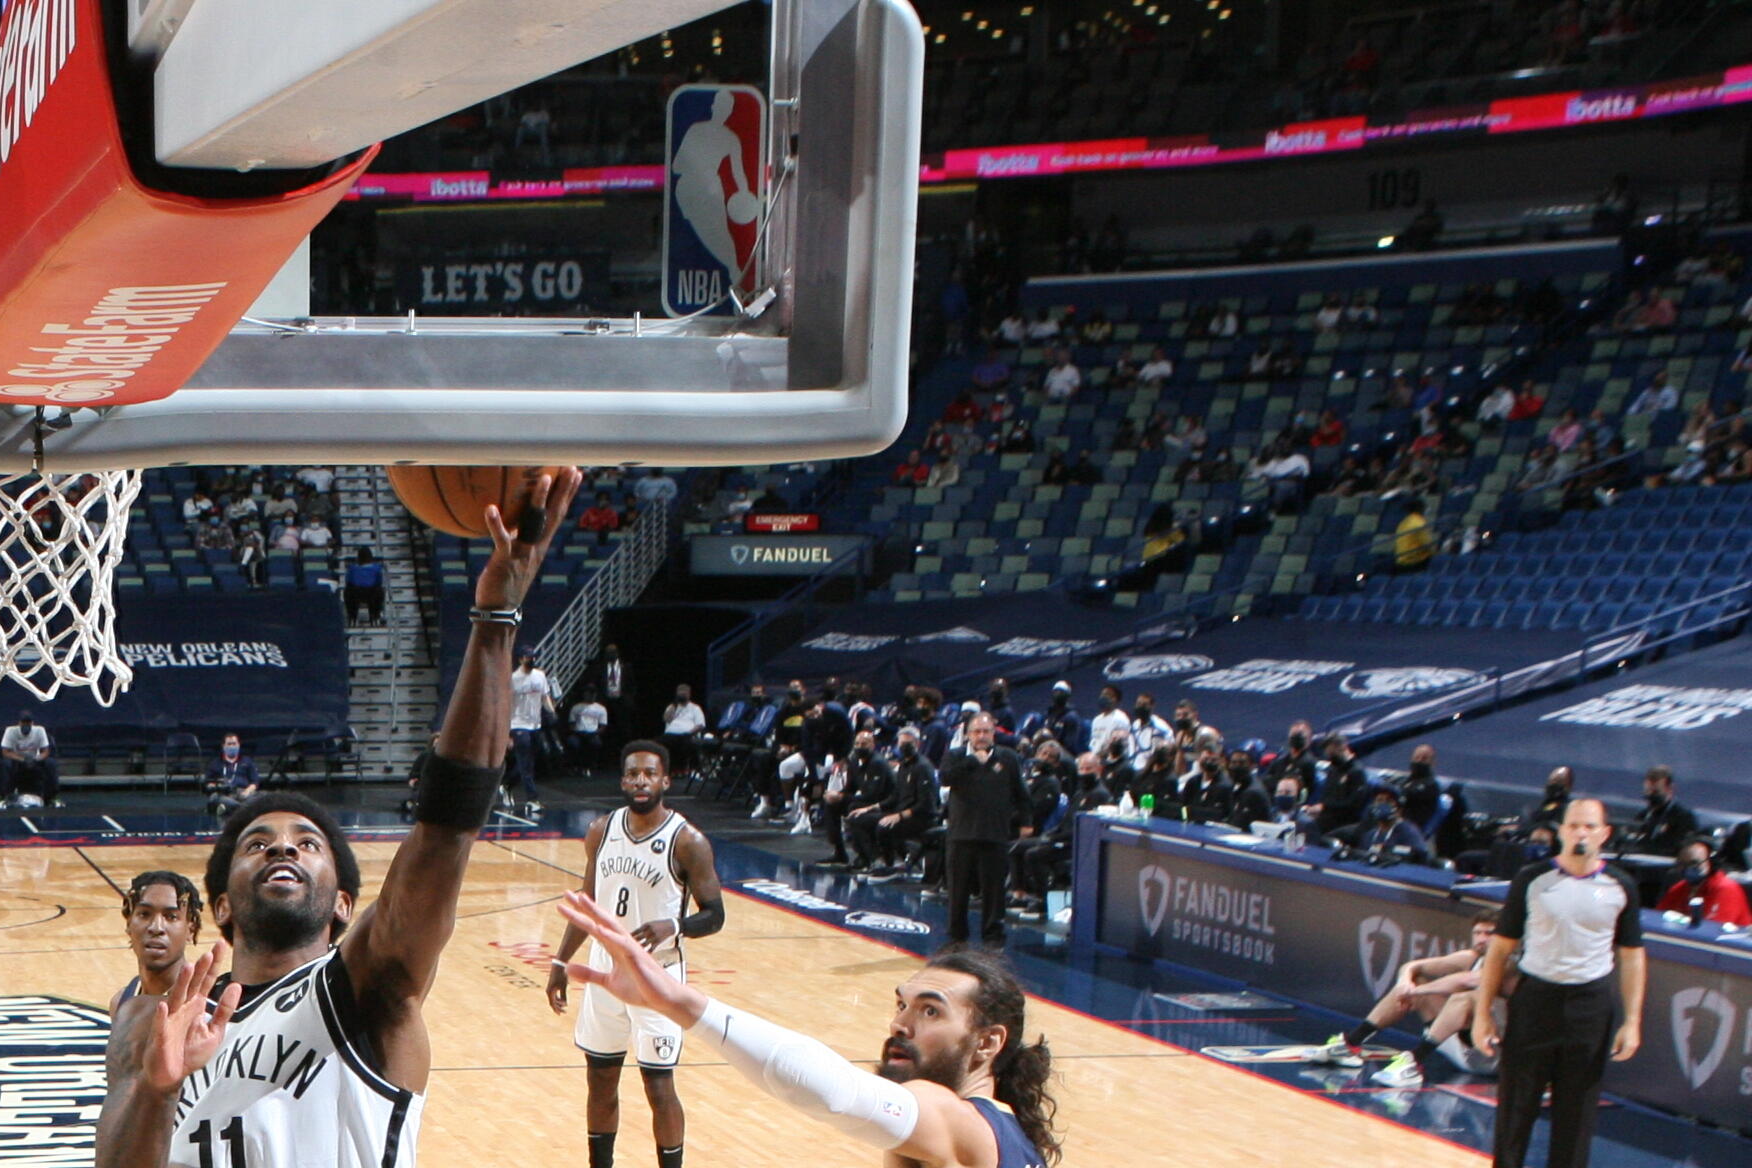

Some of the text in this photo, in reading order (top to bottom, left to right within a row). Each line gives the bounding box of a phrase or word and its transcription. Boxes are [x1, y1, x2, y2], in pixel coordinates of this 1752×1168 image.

[429, 177, 489, 198] ibotta
[1367, 167, 1423, 210] 109
[421, 261, 584, 305] LET'S GO
[677, 269, 723, 306] NBA
[755, 514, 809, 525] EMERGENCY
[772, 524, 793, 533] EXIT
[752, 547, 833, 564] FANDUEL
[119, 641, 280, 654] NEW ORLEANS
[123, 651, 289, 668] PELICANS
[600, 856, 664, 888] BROOKLYN
[616, 886, 630, 918] 8
[1173, 876, 1276, 936] FANDUEL
[1171, 918, 1276, 967] SPORTSBOOK
